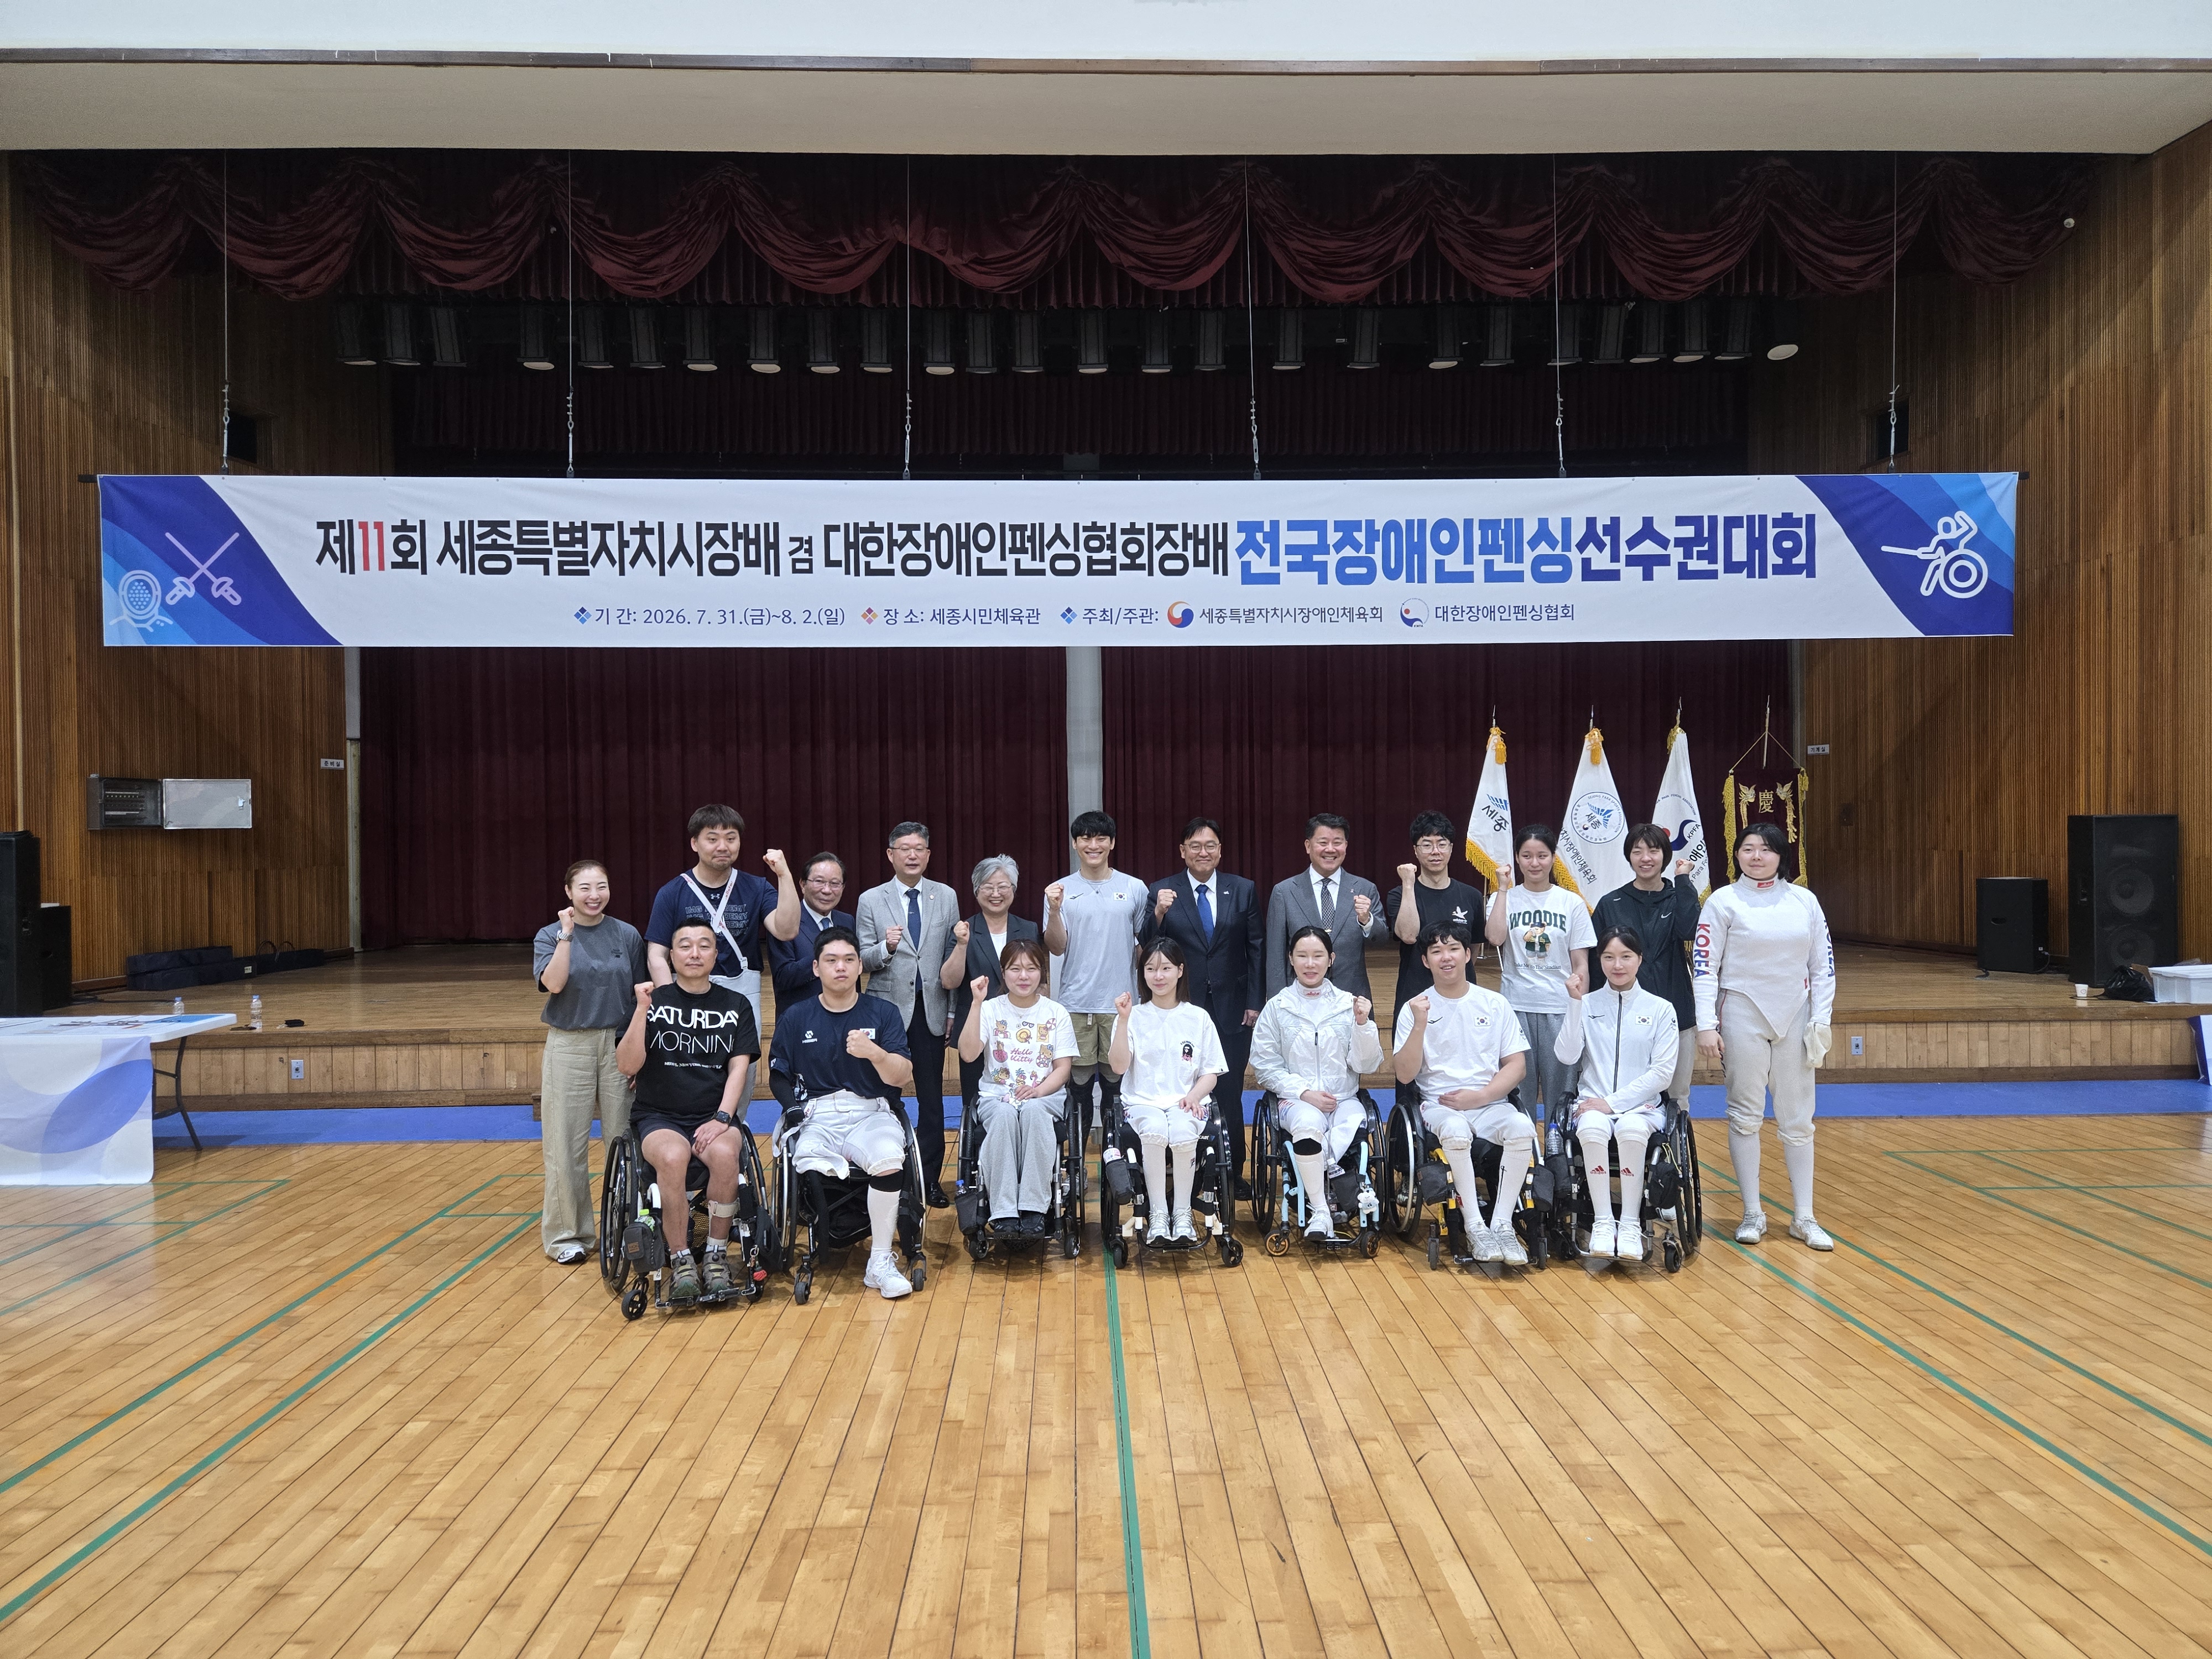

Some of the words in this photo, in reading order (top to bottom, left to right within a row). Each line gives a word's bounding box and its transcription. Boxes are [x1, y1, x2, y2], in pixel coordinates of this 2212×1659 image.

[316, 519, 427, 575] 제11회
[436, 519, 780, 577] 세종특별자치시장배
[788, 535, 813, 574] 겸
[823, 521, 1228, 577] 대한장애인펜싱협회장배
[1235, 512, 1816, 586] 전국장애인펜싱선수권대회
[643, 609, 691, 625] 2026.
[697, 609, 711, 624] 7.
[802, 608, 844, 626] 2.(일)
[930, 608, 1041, 625] 세종시민체육관
[1082, 607, 1159, 625] 주최/주관:
[1199, 606, 1383, 624] 세종특별자치시장애인체육회
[1435, 603, 1574, 622] 대한장애인펜싱협회
[1759, 789, 1774, 813] 慶
[1481, 805, 1509, 832] 세종
[1585, 812, 1602, 830] 세종
[1687, 823, 1701, 839] KPFA
[1559, 828, 1597, 885] 치시장애인체육회
[1692, 866, 1704, 879] Para
[685, 905, 703, 914] IMG
[1510, 909, 1567, 933] WOODIE
[1694, 924, 1710, 978] KOREA
[650, 1030, 735, 1054] ORNIN
[1010, 1055, 1034, 1064] Kitty
